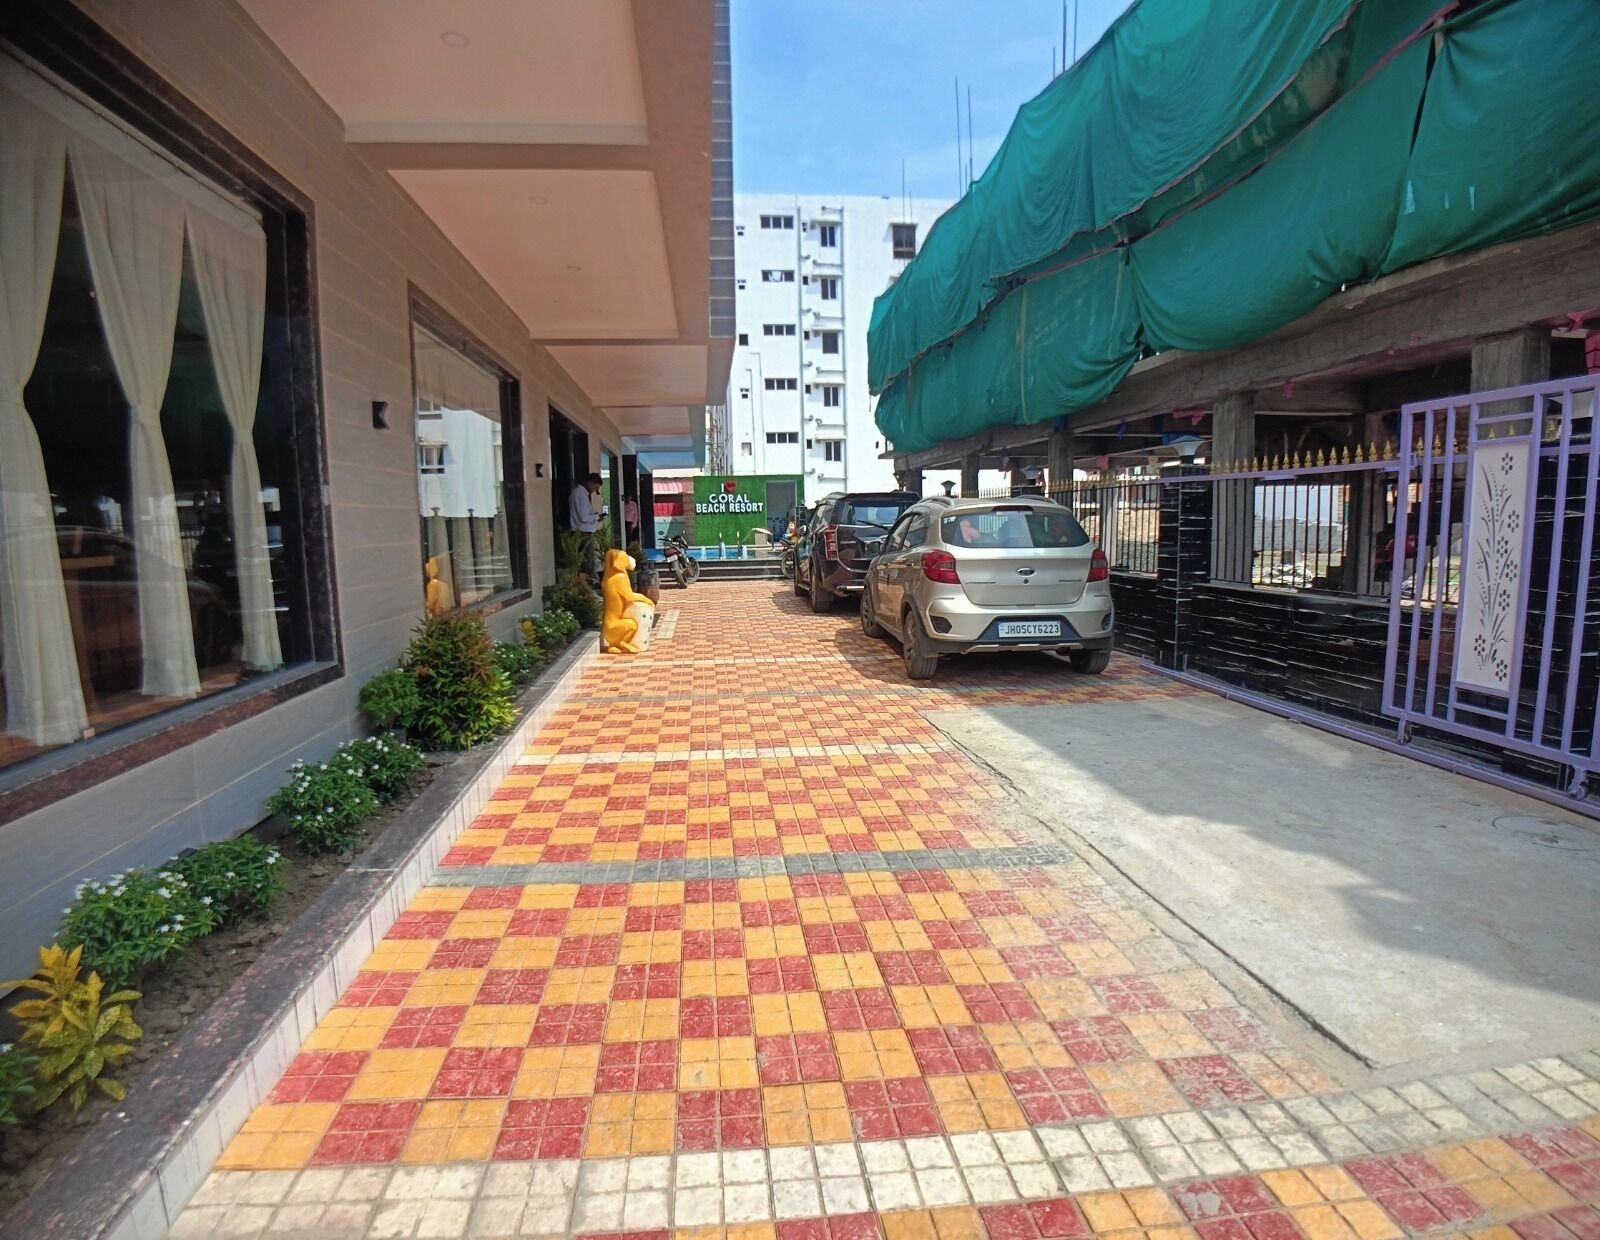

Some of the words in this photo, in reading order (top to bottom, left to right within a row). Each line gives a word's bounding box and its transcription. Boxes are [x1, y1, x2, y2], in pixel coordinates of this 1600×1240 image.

[721, 483, 725, 493] I
[709, 493, 750, 503] CORAL
[696, 503, 726, 513] BEACH
[729, 502, 764, 513] RESORT
